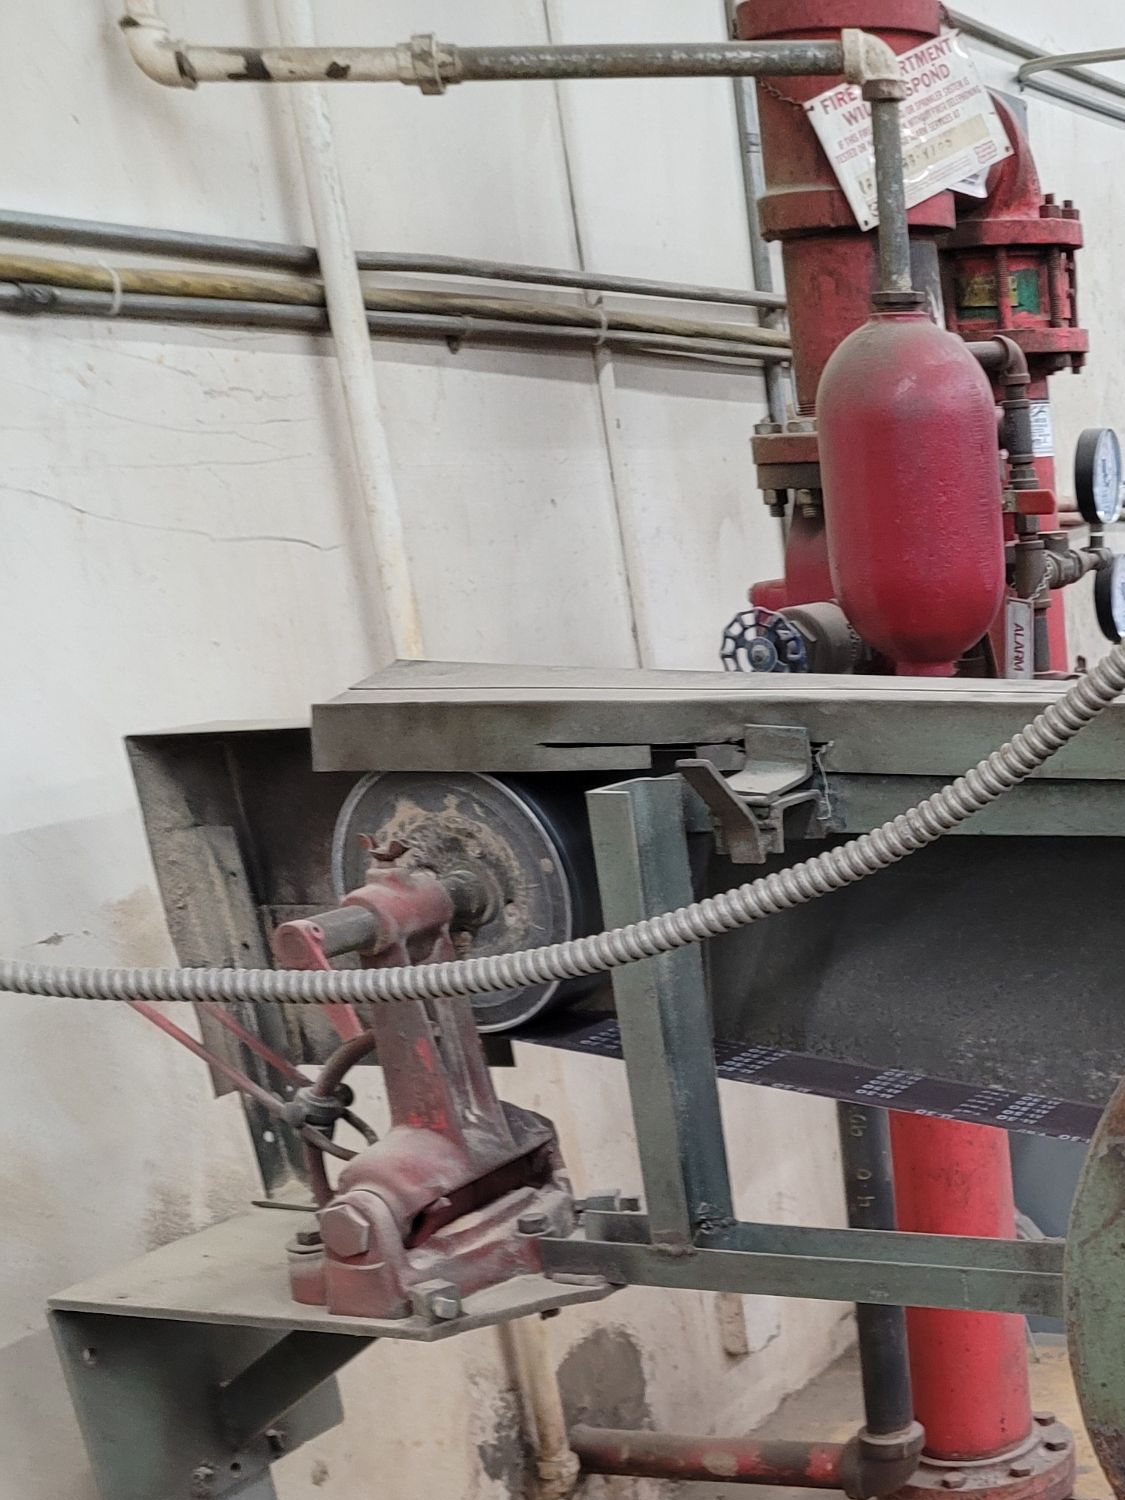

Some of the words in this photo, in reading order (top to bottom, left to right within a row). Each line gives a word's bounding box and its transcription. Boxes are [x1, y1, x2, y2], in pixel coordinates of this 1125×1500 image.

[820, 86, 858, 115] FIRE
[897, 37, 953, 77] RTMENT
[842, 103, 873, 127] WIL
[904, 62, 952, 97] SPOND
[1013, 623, 1024, 671] ALARM
